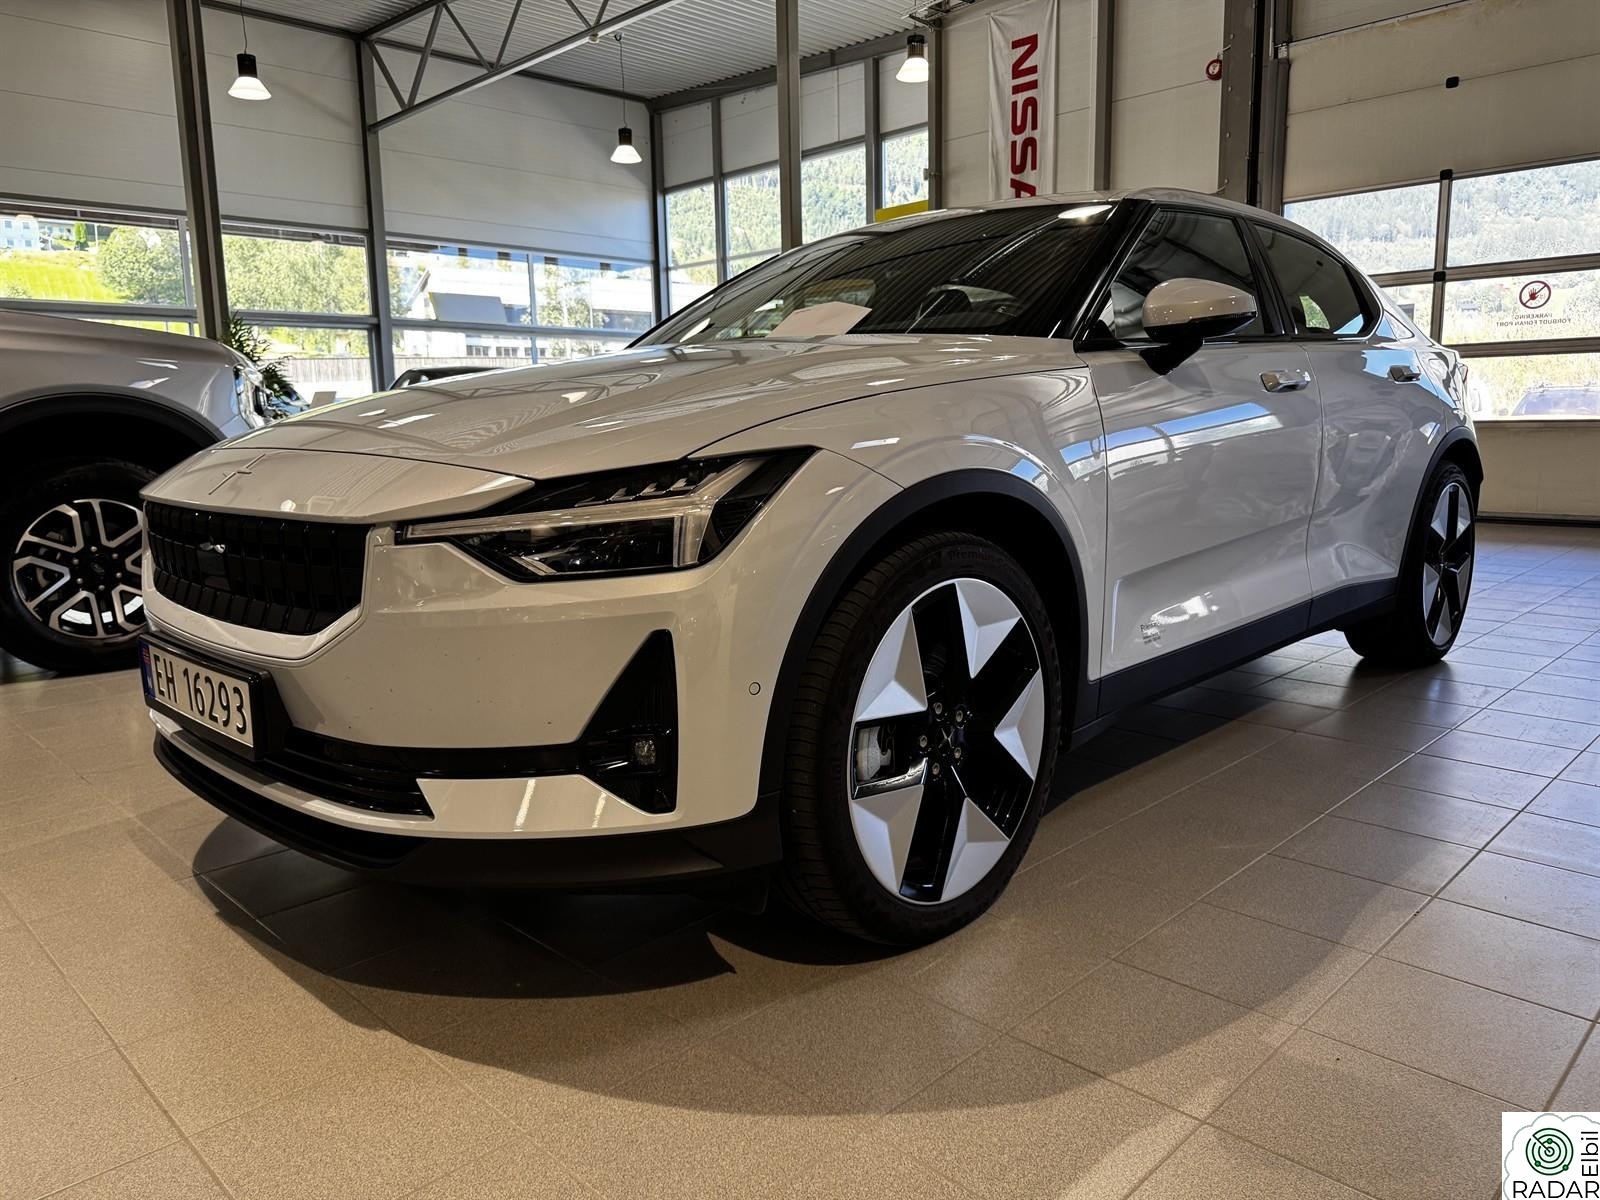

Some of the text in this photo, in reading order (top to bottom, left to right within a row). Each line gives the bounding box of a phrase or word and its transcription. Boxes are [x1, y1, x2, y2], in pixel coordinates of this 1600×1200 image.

[1010, 33, 1038, 199] NISSA
[153, 653, 247, 735] EH 16293
